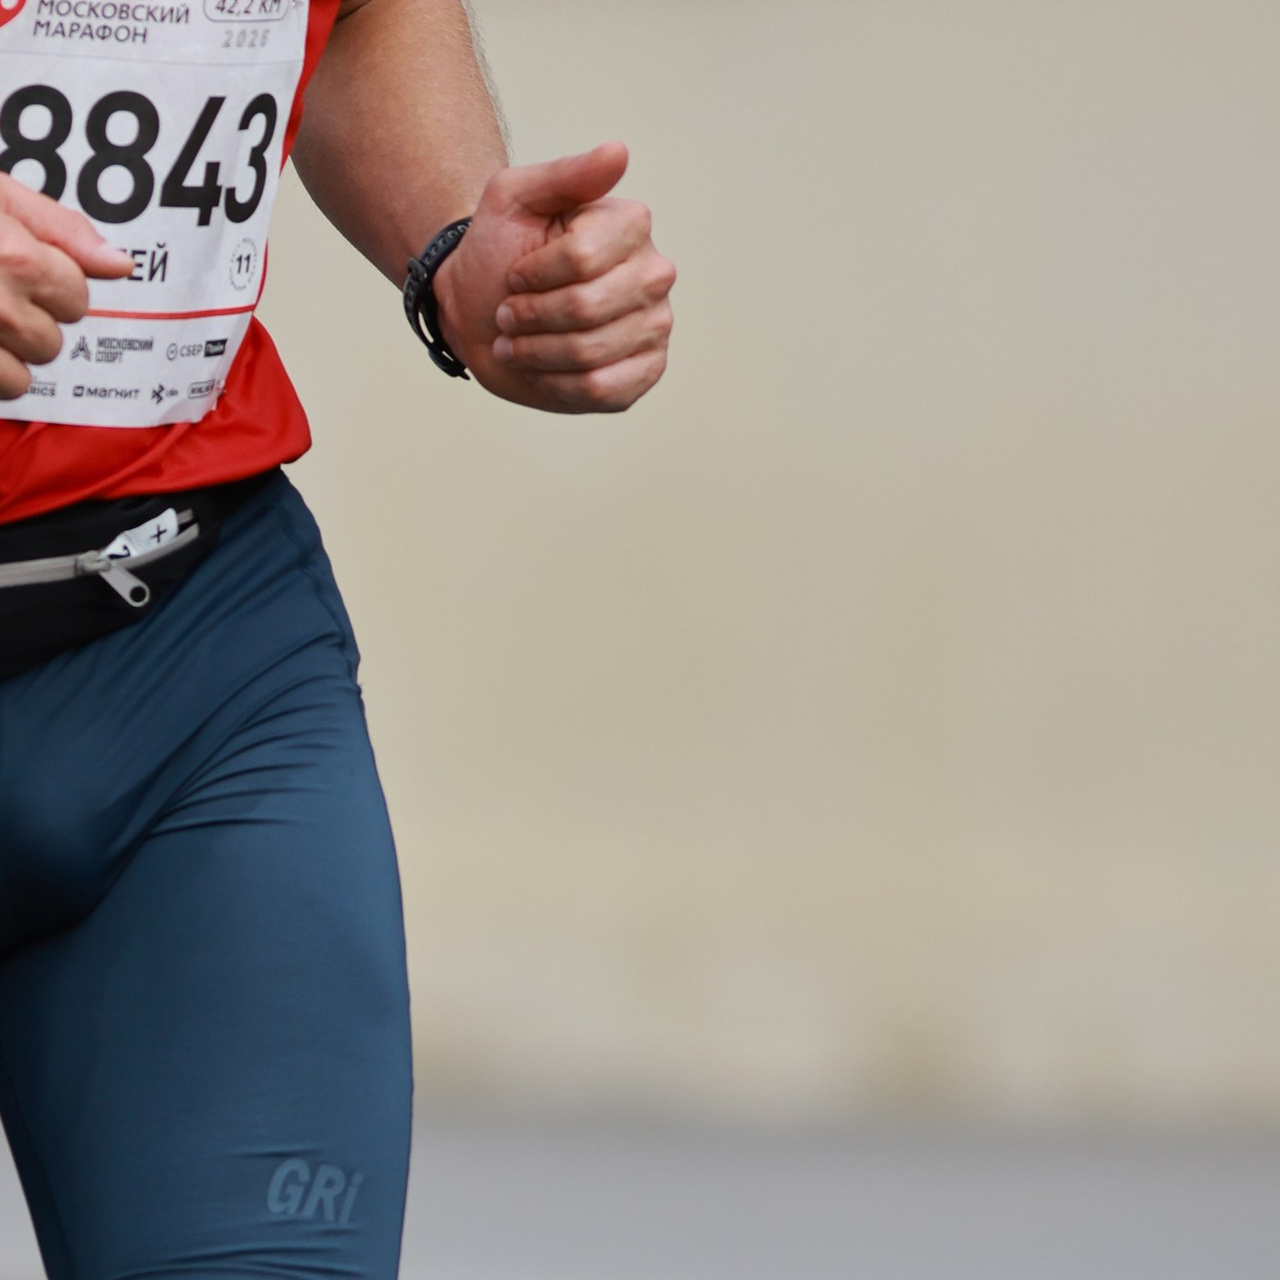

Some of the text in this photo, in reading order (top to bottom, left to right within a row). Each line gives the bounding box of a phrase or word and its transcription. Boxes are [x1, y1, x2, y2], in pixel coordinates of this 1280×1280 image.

[32, 20, 148, 44] МАРАФОН
[117, 242, 169, 282] ЕЙ
[236, 253, 251, 274] 11
